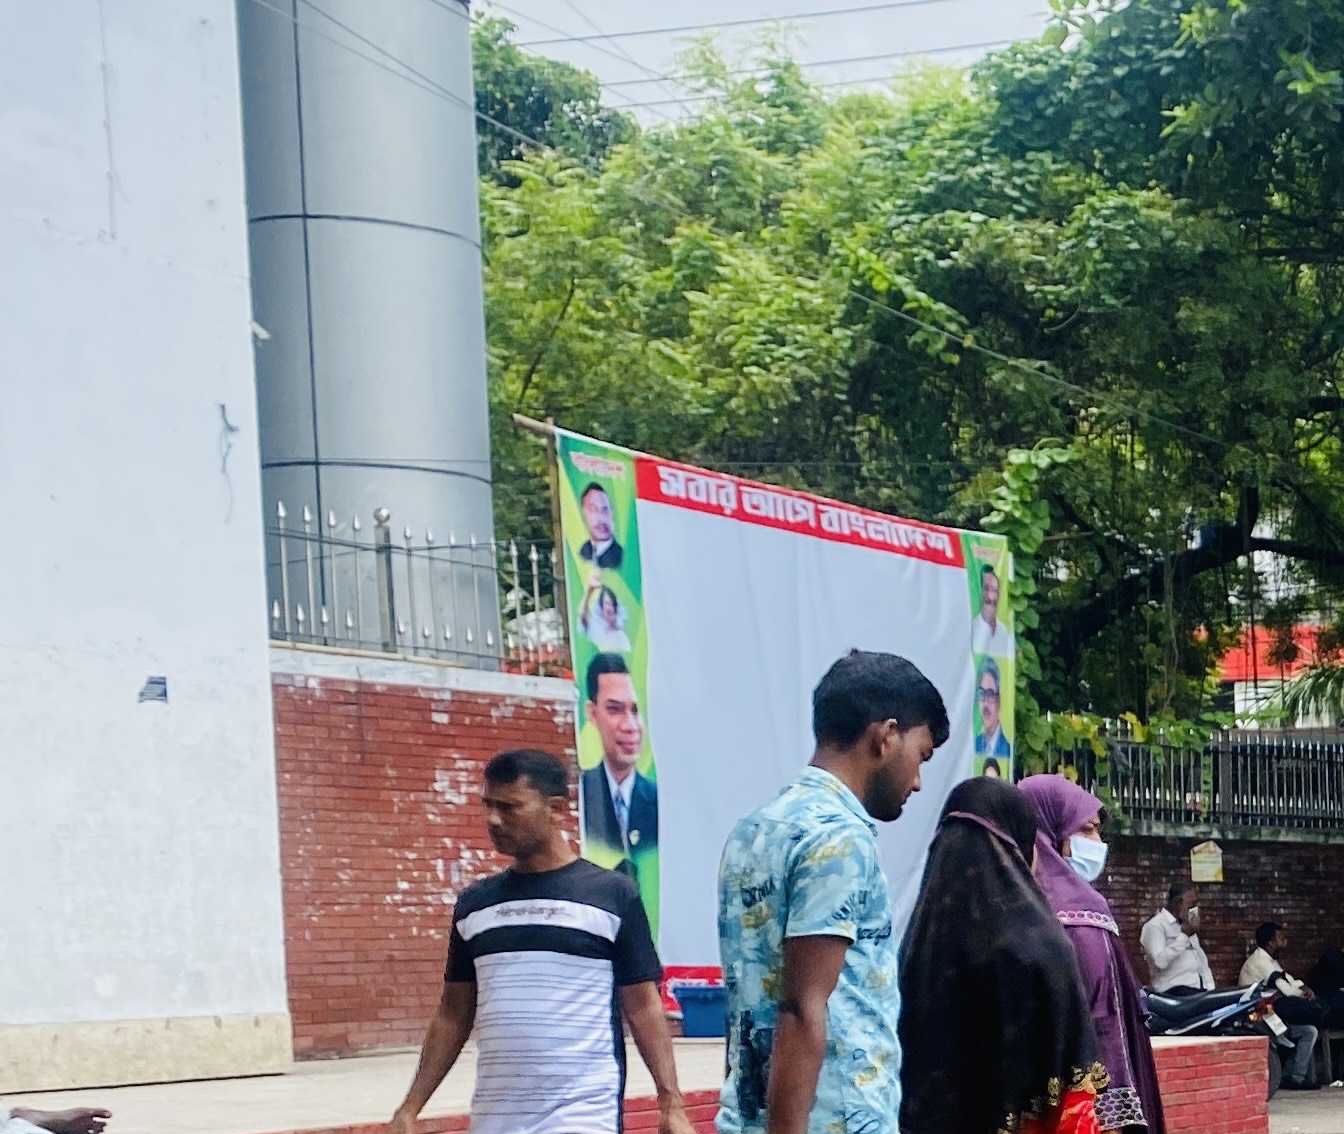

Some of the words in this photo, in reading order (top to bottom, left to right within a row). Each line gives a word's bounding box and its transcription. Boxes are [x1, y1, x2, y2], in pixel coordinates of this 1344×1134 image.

[659, 465, 737, 516] সবার
[741, 485, 815, 528] আগে
[820, 503, 953, 558] বাংলাদেশ
